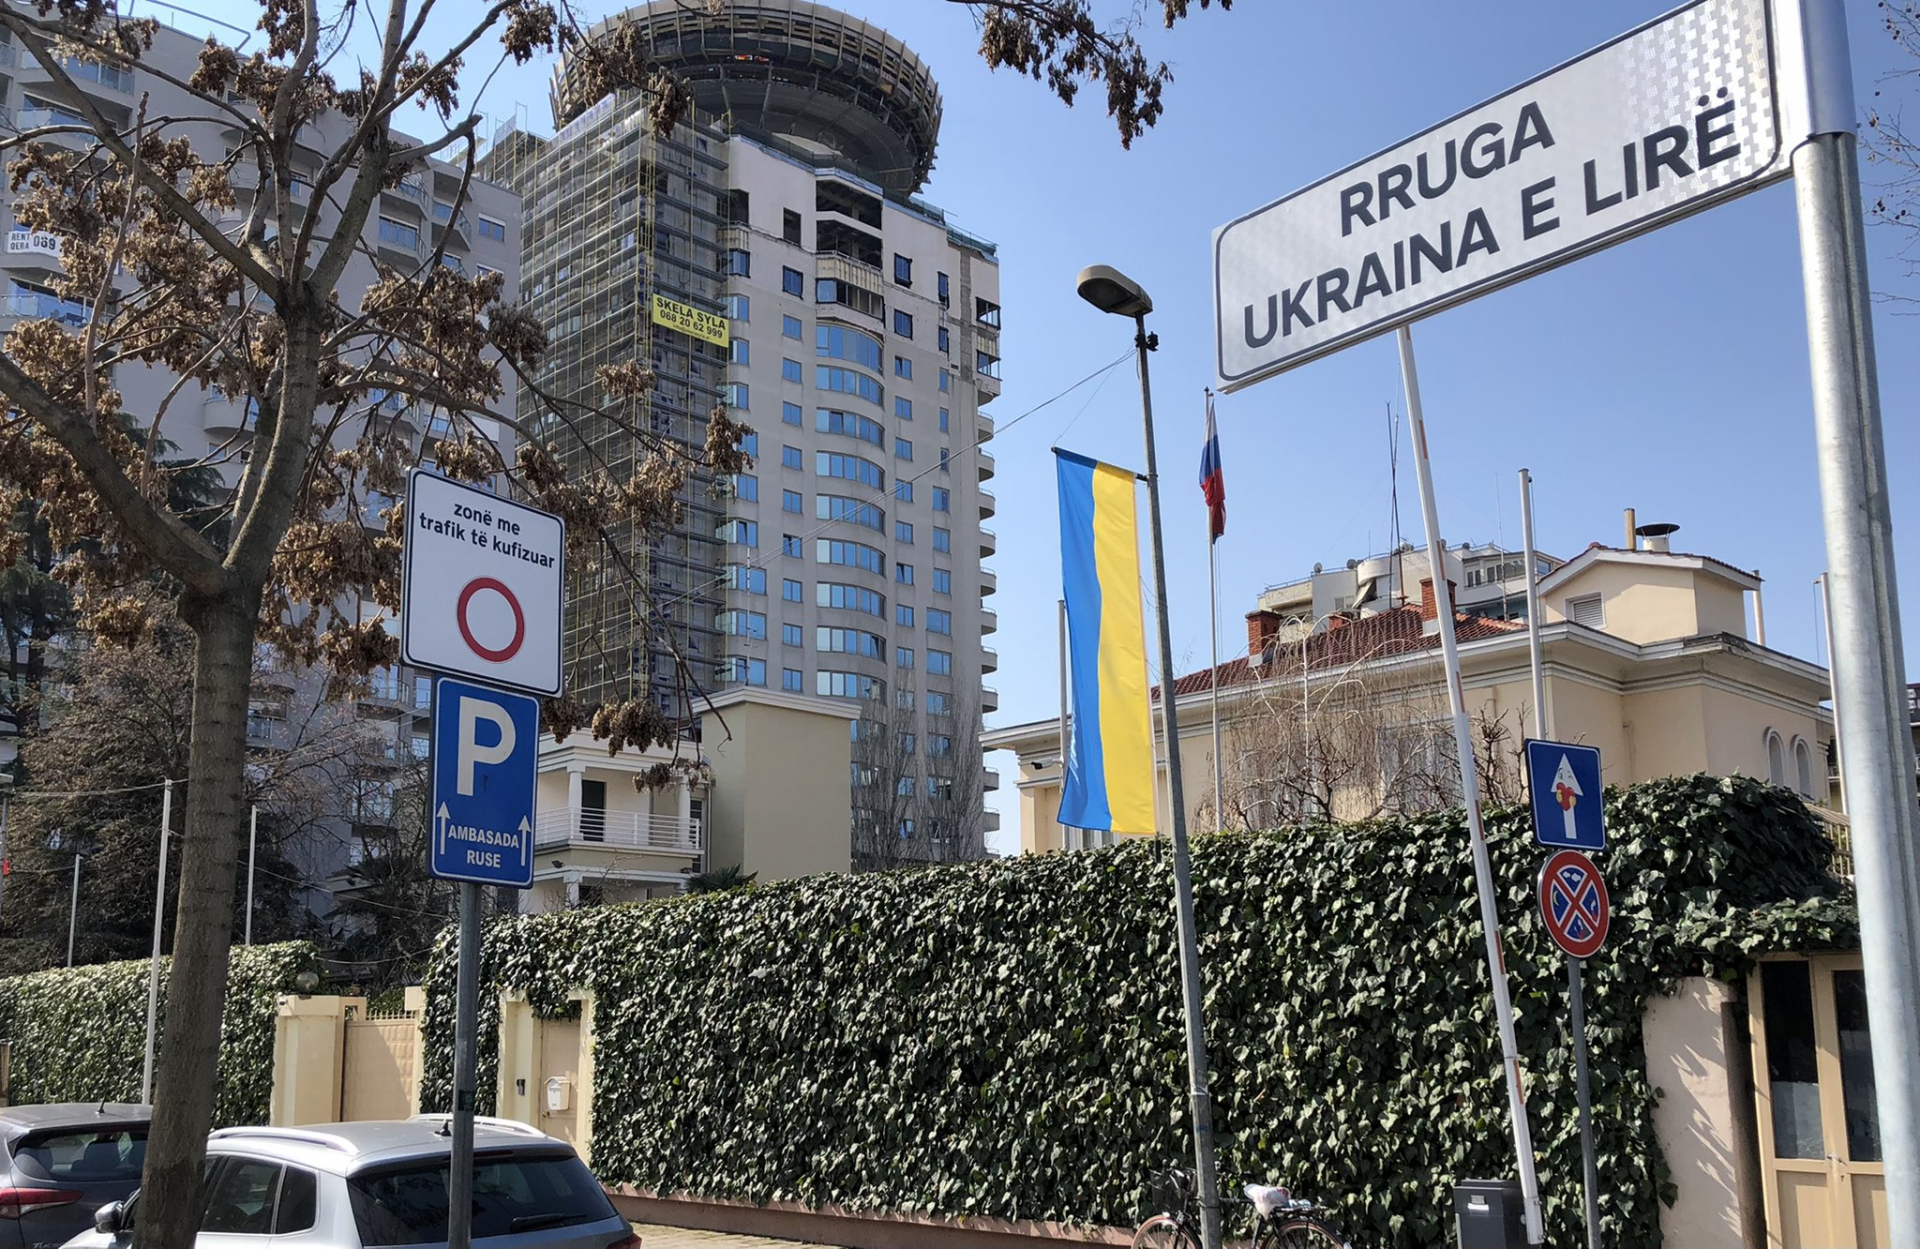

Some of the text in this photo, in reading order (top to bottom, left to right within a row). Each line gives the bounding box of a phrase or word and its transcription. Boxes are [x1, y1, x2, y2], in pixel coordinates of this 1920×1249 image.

[1339, 100, 1556, 238] RRUGA
[1243, 86, 1742, 349] UKRAINA E LIRË
[656, 297, 726, 331] SKELA SYLA
[660, 309, 677, 323] 068
[679, 316, 691, 328] 20
[693, 321, 704, 333] 62
[706, 325, 723, 339] 999
[453, 503, 521, 536] zonë me
[419, 512, 556, 569] trafik të kufizuar
[456, 695, 517, 797] P
[447, 824, 520, 849] AMBASADA
[466, 849, 502, 869] RUSE
